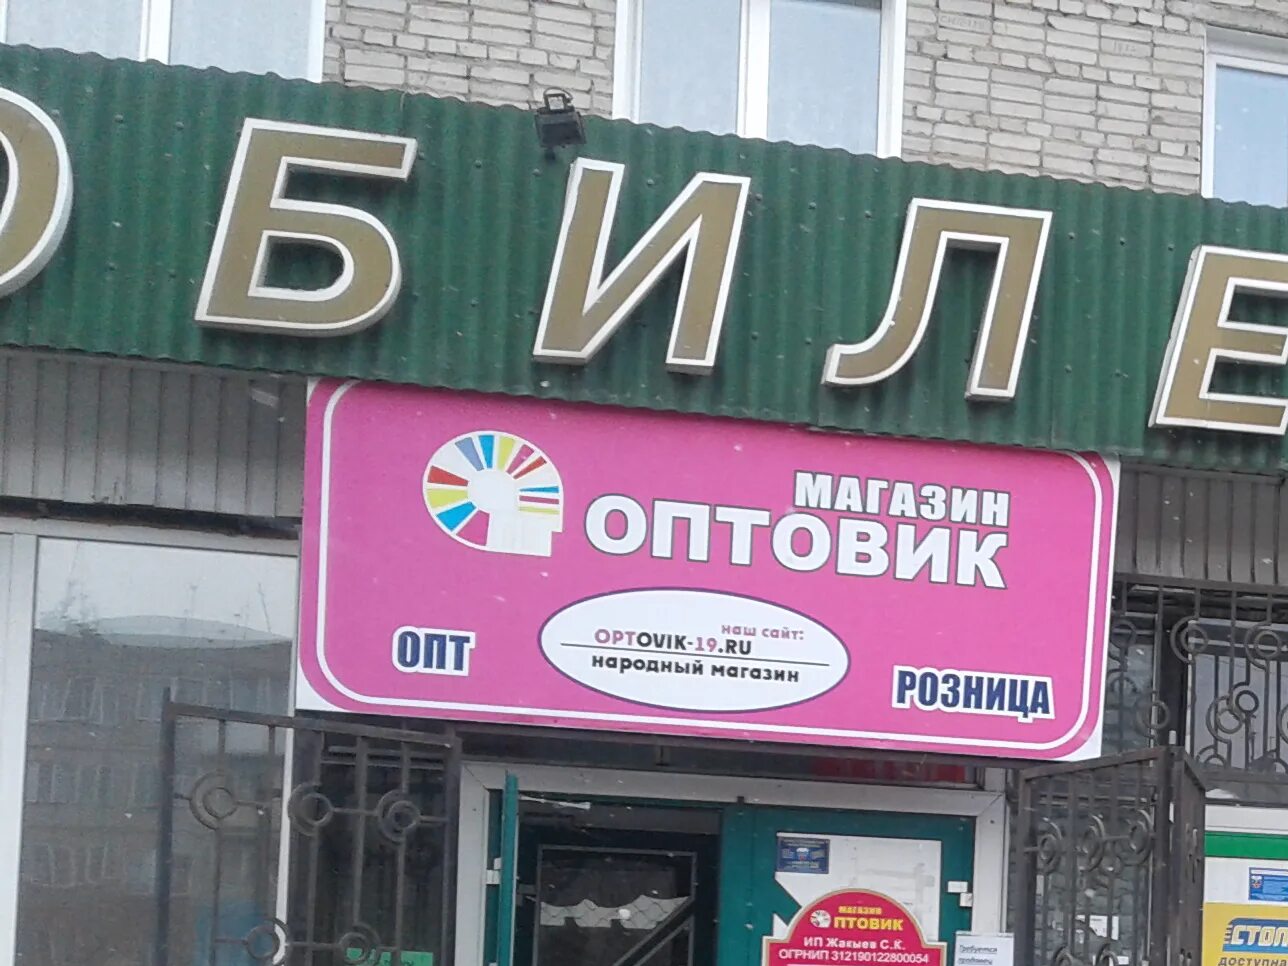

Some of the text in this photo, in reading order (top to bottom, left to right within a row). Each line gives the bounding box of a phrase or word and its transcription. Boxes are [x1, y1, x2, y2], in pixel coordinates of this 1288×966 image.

[794, 469, 1010, 526] МАГАЗИН
[584, 494, 1010, 590] ОПТОВИК
[594, 628, 753, 656] OPTOVIK-19.RU
[721, 624, 804, 641] наш сайт:
[396, 629, 473, 674] ОПТ
[591, 655, 800, 683] народный магазин
[896, 668, 1053, 721] РОЗНИЦА
[803, 936, 823, 947] ИП
[778, 949, 930, 964] ОГРНИП 312190122800054
